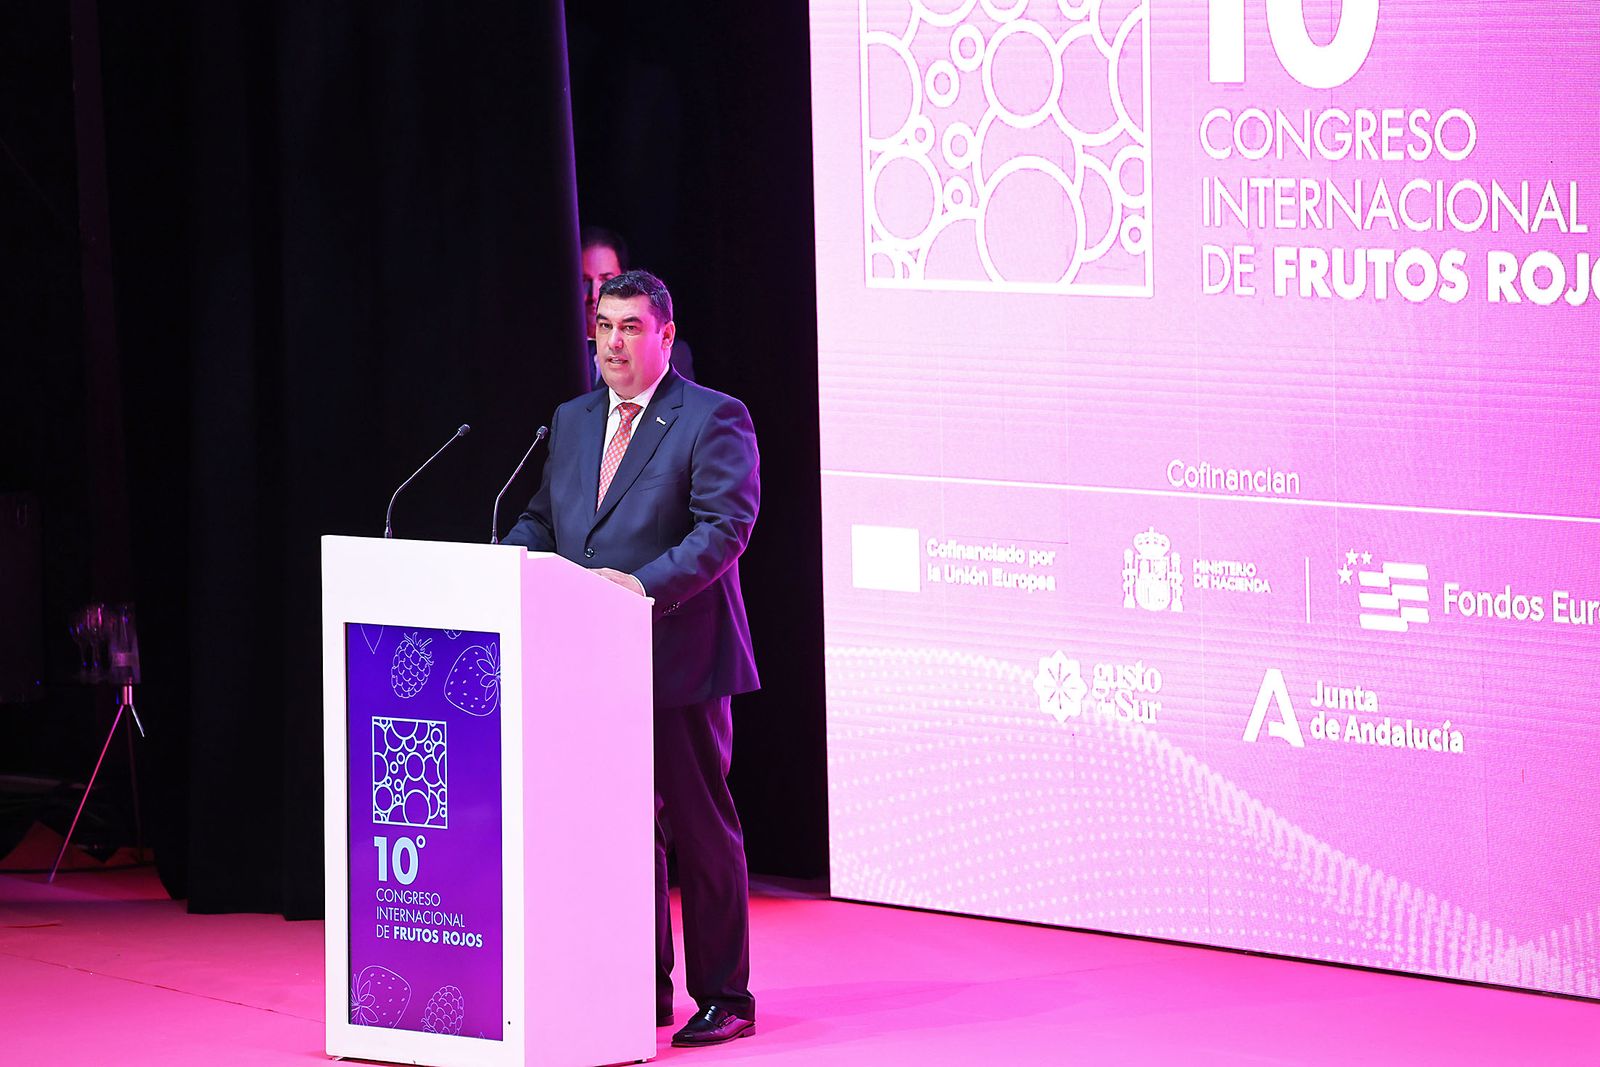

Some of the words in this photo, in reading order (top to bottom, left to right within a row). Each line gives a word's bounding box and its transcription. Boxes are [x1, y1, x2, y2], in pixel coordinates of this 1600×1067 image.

[1200, 107, 1477, 161] CONGRESO
[1202, 176, 1588, 233] INTERNACIONAL
[1202, 244, 1256, 296] DE
[1273, 246, 1470, 303] FRUTOS
[1487, 250, 1600, 306] ROJ
[1166, 459, 1301, 494] Cofinancian
[926, 538, 1025, 563] Cofinanciado
[1028, 549, 1056, 567] por
[1192, 560, 1256, 577] MINISTERIO
[944, 564, 988, 586] Unión
[991, 567, 1056, 592] Europea
[1210, 576, 1271, 593] HACIENDA
[1442, 582, 1545, 622] Fondos
[1552, 590, 1600, 625] Eur
[1092, 660, 1162, 700] gusto
[1310, 680, 1379, 712] Junta
[1309, 712, 1340, 740] de
[1344, 715, 1464, 753] Andalucía
[376, 888, 441, 907] CONGRESO
[376, 906, 465, 928] INTERNACIONAL
[376, 925, 390, 939] DE
[393, 926, 439, 943] FRUTOS
[442, 930, 483, 948] ROJOS
